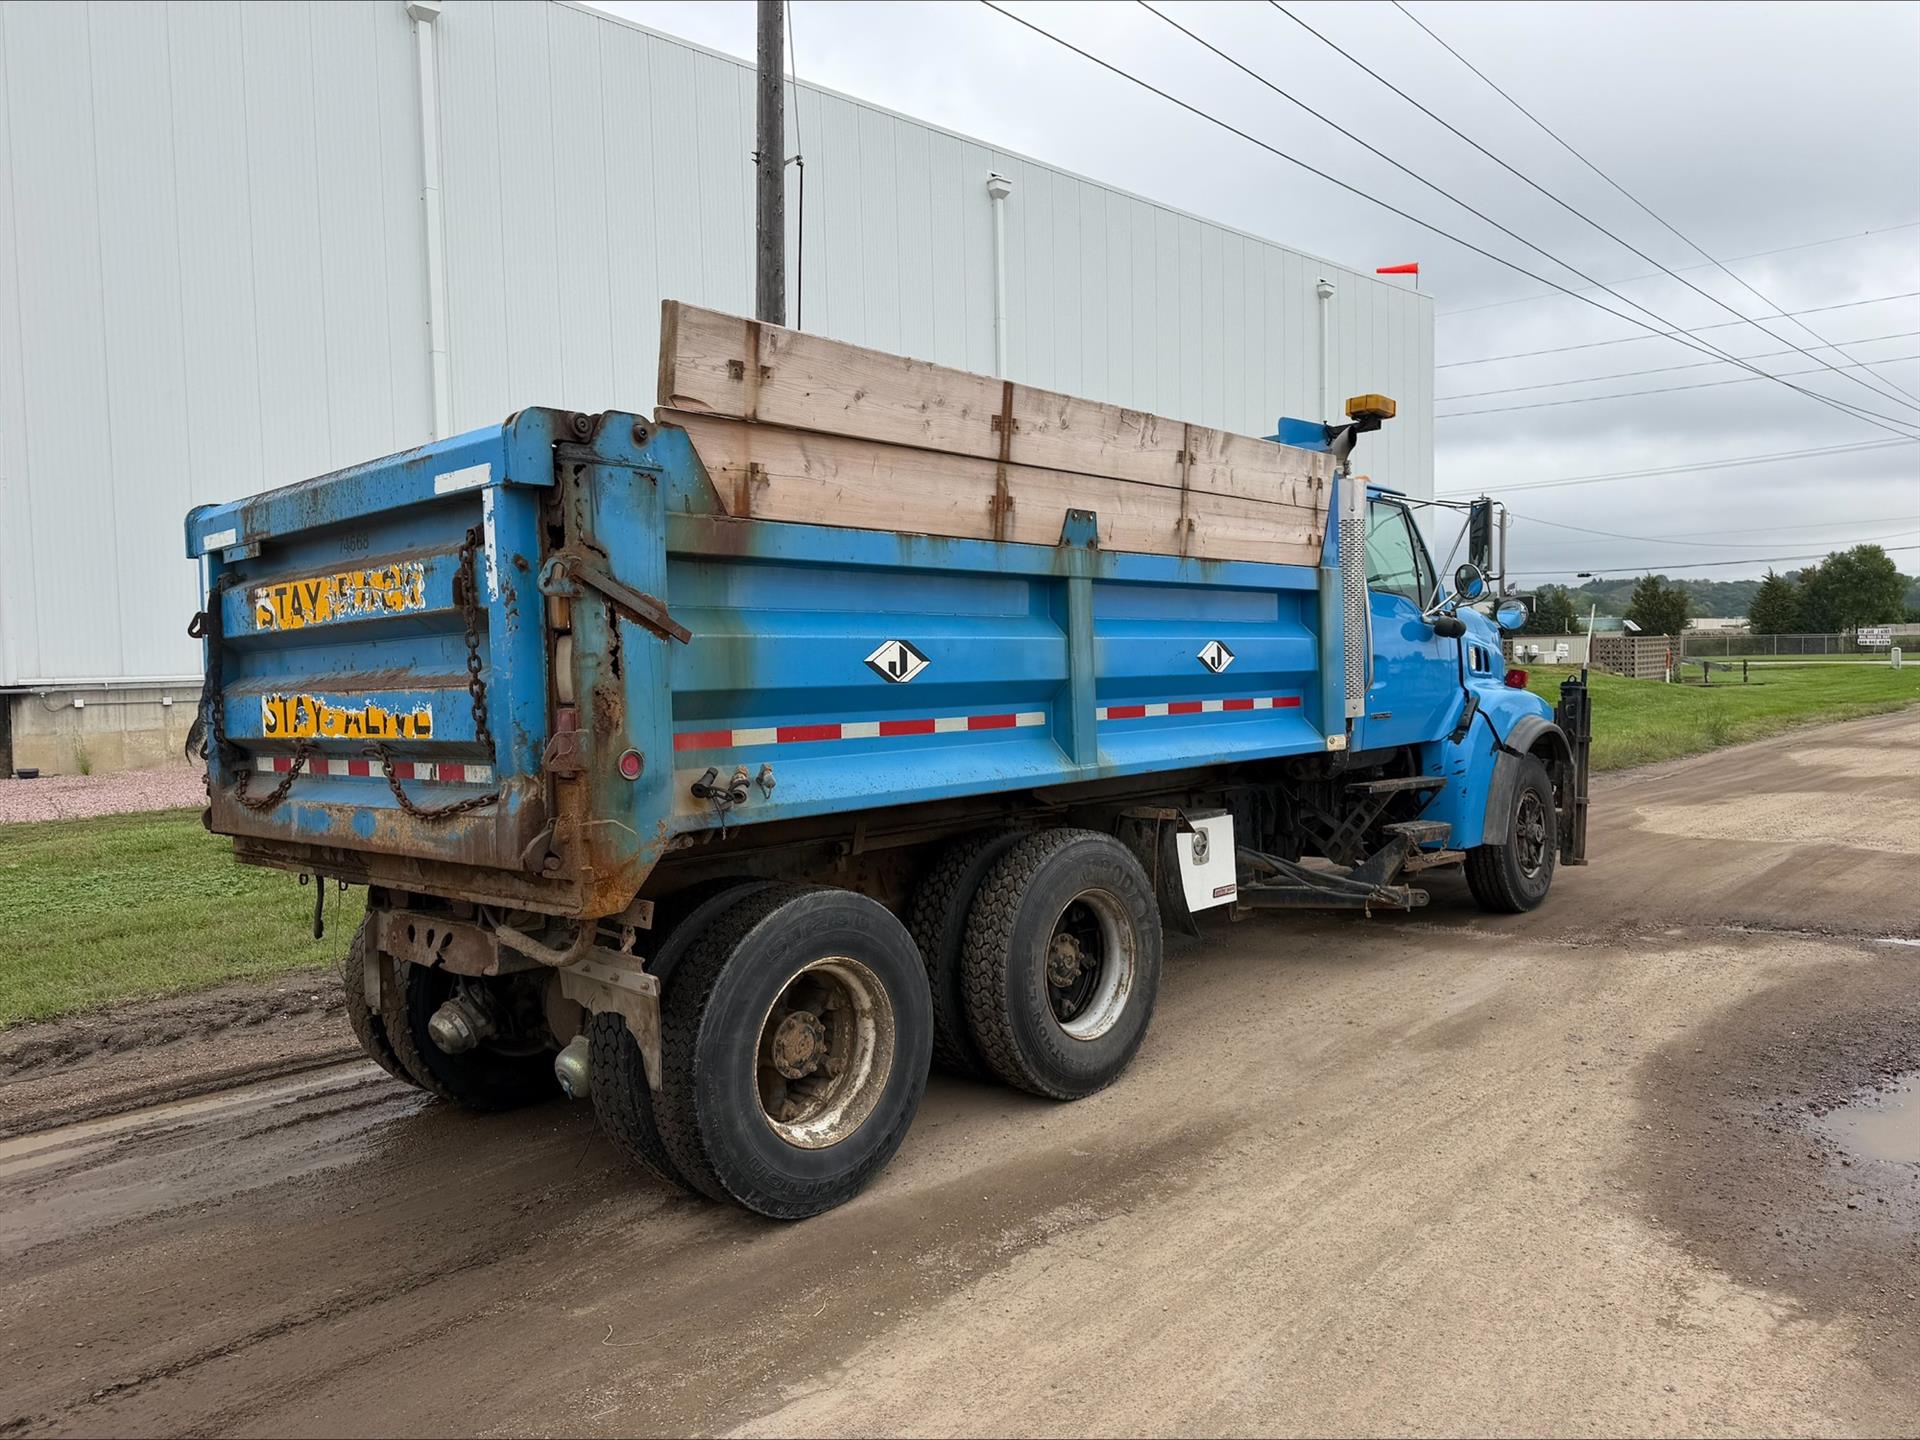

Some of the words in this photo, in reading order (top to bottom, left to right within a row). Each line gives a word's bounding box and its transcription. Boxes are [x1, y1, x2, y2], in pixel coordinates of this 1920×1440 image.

[256, 581, 321, 627] STAY
[888, 644, 908, 679] J
[1211, 645, 1222, 670] J
[263, 695, 321, 734] STAY
